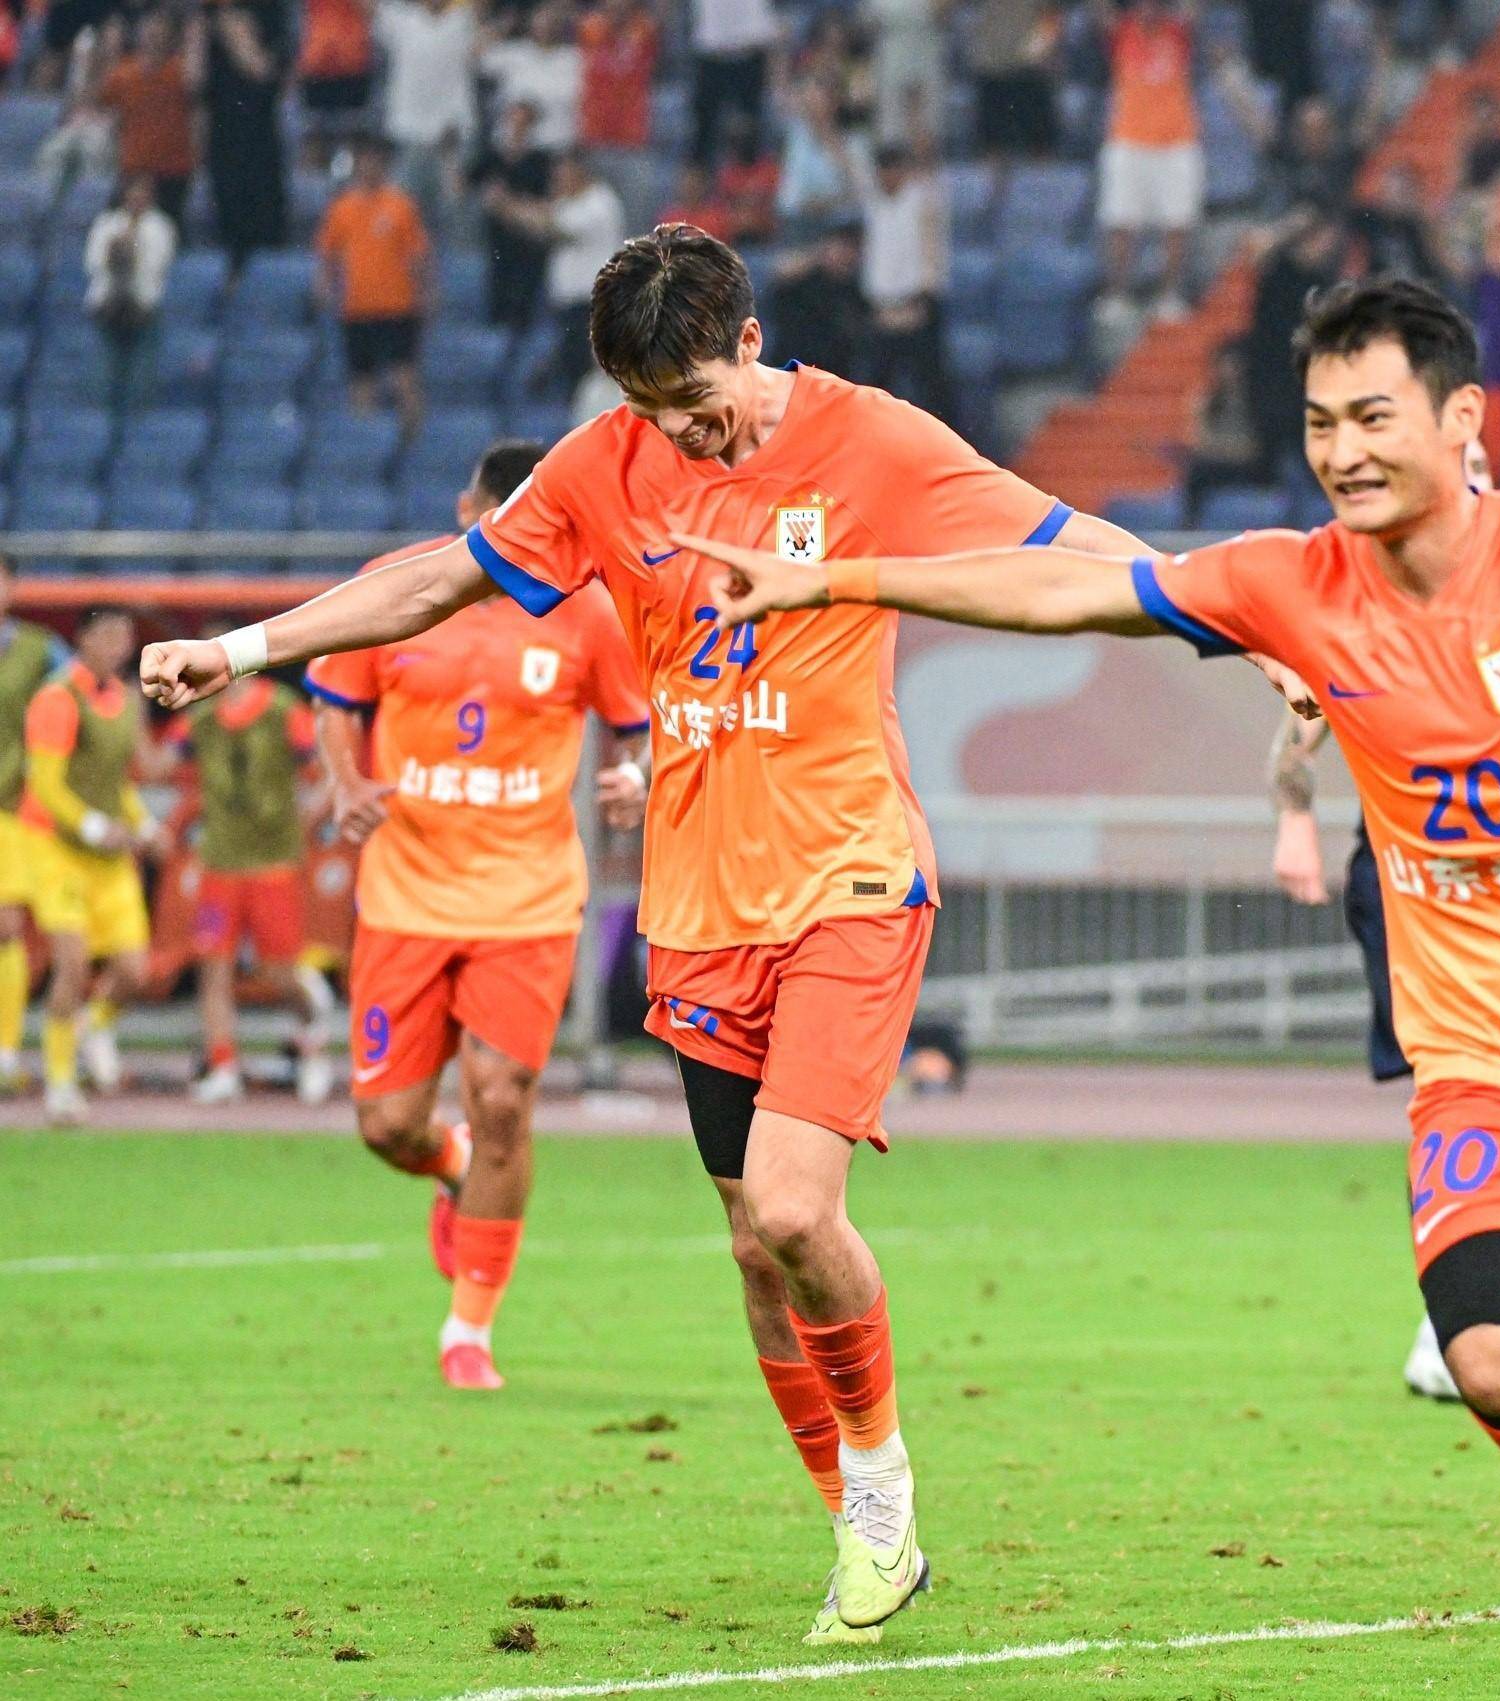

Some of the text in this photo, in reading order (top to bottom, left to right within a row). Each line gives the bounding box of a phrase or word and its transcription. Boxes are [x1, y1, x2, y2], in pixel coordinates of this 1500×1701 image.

[689, 606, 759, 680] 24
[456, 701, 488, 754] 9
[363, 1005, 390, 1062] 9
[1411, 1129, 1499, 1216] 20
